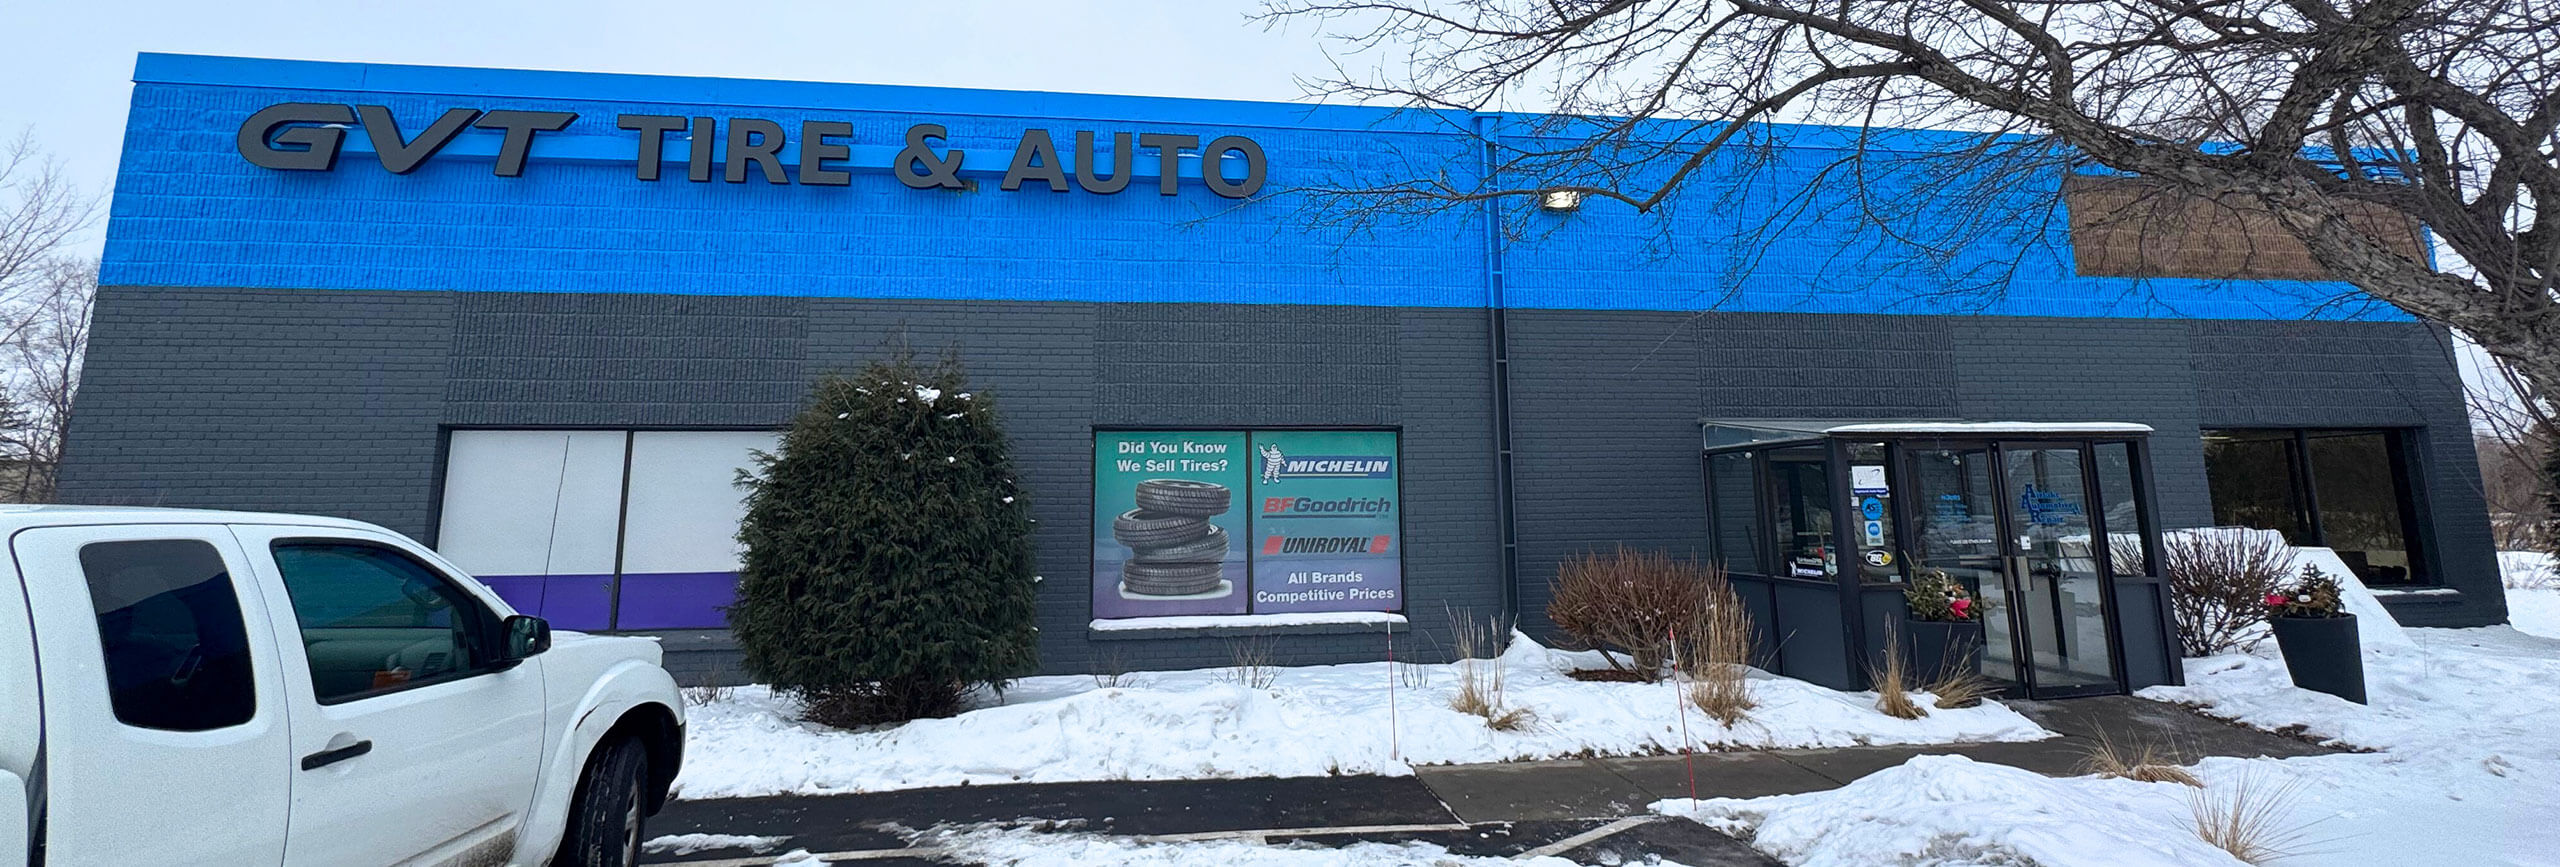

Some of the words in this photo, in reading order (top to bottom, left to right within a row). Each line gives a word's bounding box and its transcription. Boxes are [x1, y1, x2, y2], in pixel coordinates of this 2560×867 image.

[237, 102, 579, 177] GVT
[616, 113, 853, 187] TIRE
[892, 123, 964, 191] &
[1001, 128, 1268, 200] AUTO
[1118, 441, 1145, 454] Did
[1149, 441, 1178, 454] You
[1183, 441, 1227, 454] Know
[1116, 459, 1141, 472] We
[1145, 459, 1175, 472] Sell
[1180, 459, 1228, 472] Tires?
[1287, 460, 1389, 473] MICHELIN
[1263, 497, 1391, 513] BFGoodrich
[1282, 536, 1368, 554] UNIROYAL
[1287, 572, 1307, 585] All
[1311, 570, 1363, 584] Brands
[1256, 589, 1345, 604] Competitive
[1349, 587, 1395, 600] Prices
